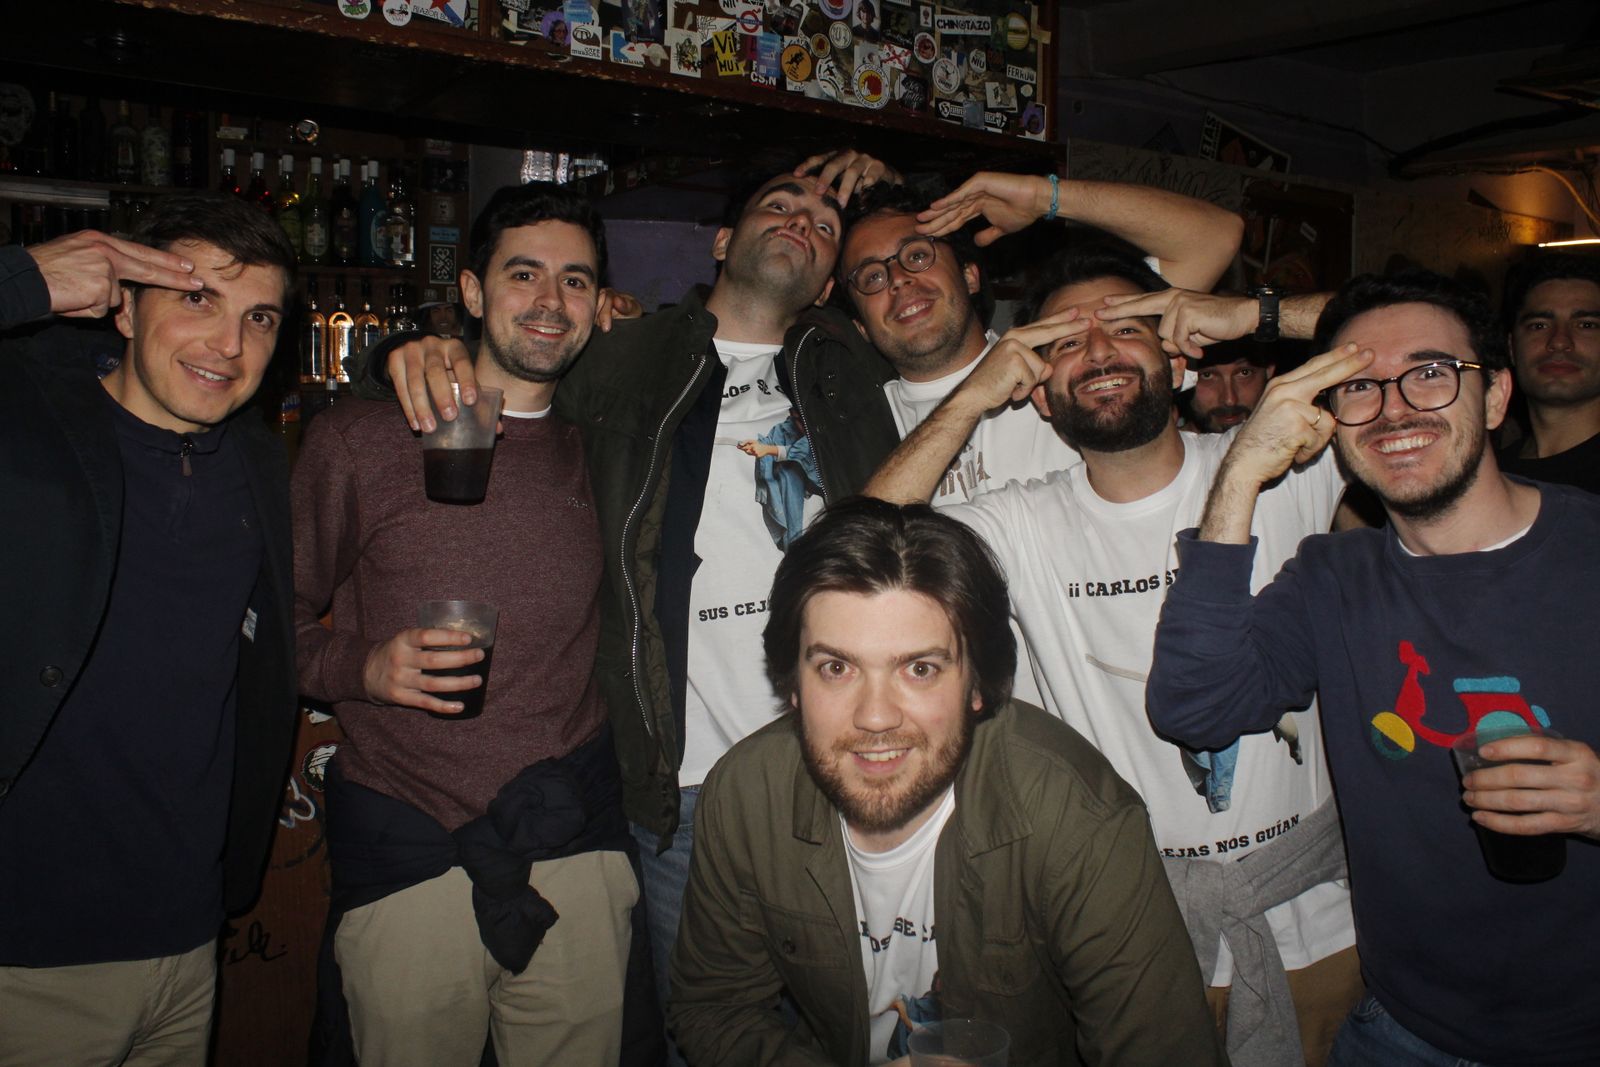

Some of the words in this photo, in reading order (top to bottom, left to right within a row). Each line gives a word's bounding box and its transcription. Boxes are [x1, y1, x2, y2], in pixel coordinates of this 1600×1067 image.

[1086, 575, 1160, 597] CARLOS
[698, 606, 729, 622] SUS
[1160, 845, 1210, 858] EJAS
[1216, 835, 1250, 853] NOS
[1255, 814, 1300, 843] GUÍAN
[893, 917, 917, 936] SE
